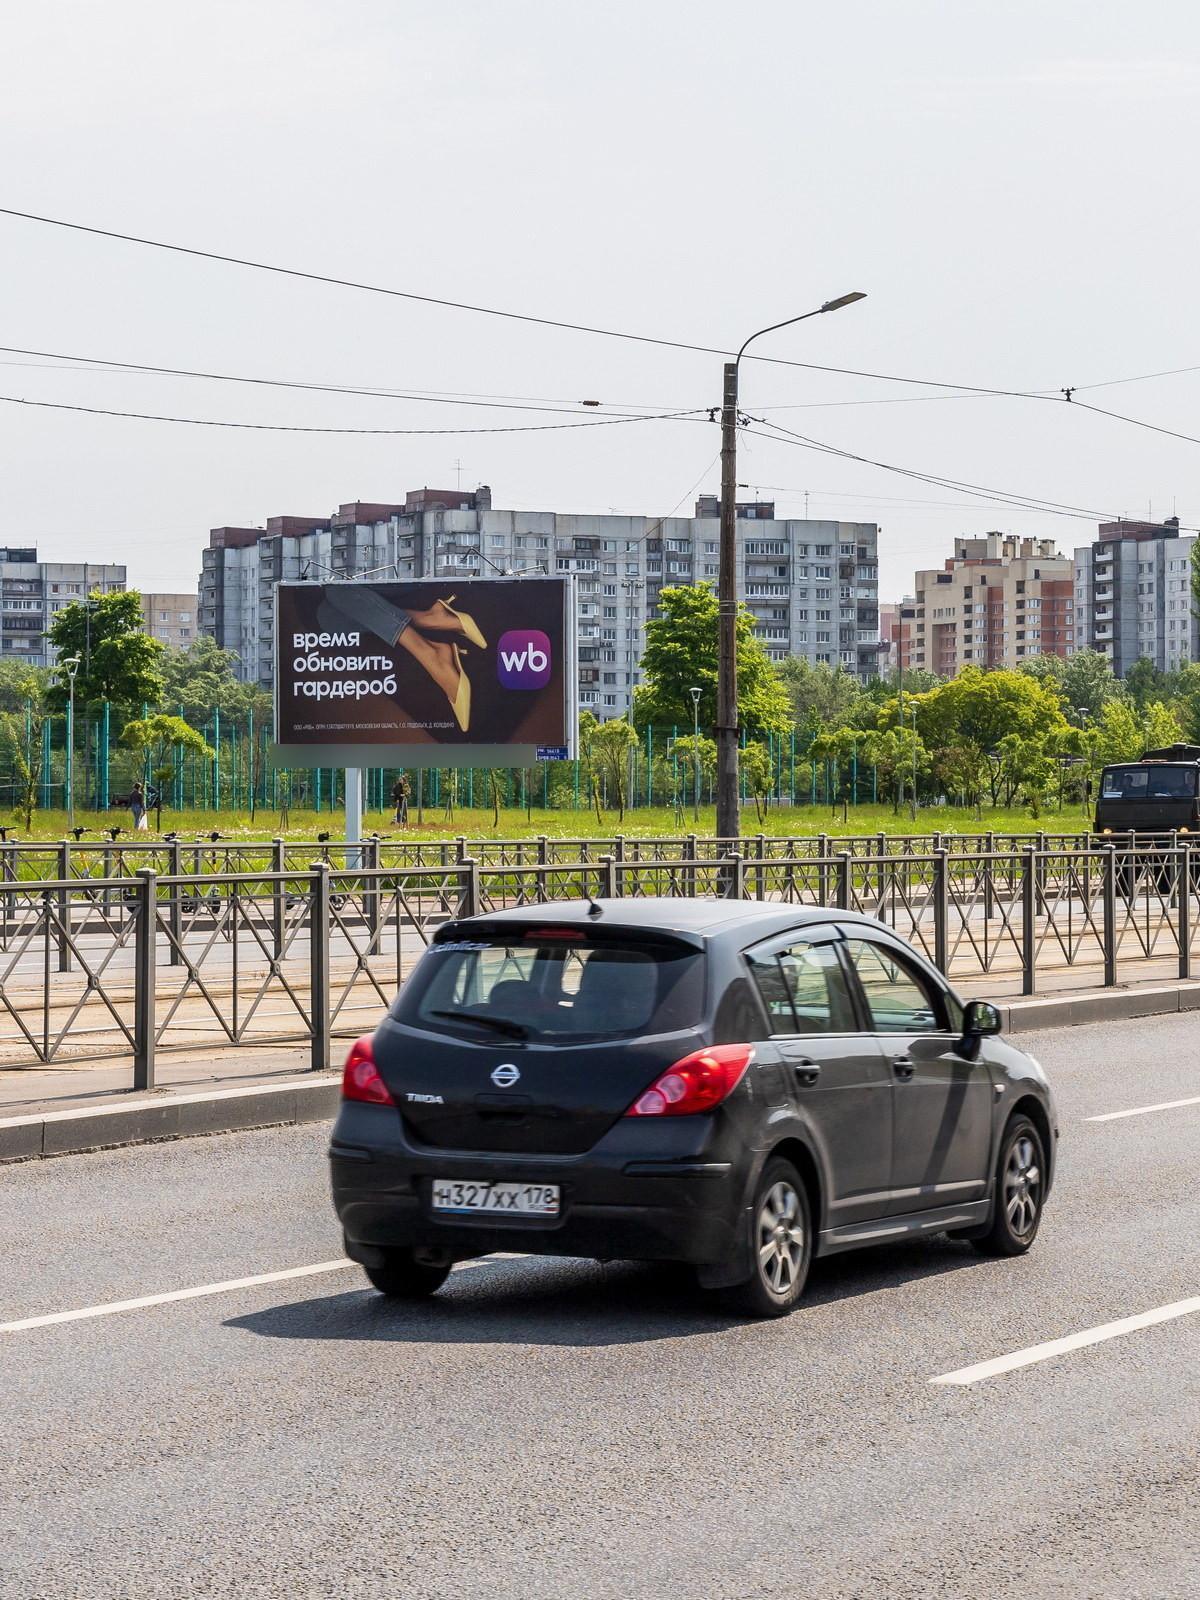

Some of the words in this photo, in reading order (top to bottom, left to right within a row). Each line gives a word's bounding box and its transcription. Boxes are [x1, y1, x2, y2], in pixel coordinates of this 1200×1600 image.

[293, 632, 360, 653] время
[293, 651, 394, 672] обновить
[500, 642, 548, 672] wb
[293, 674, 398, 701] гардероб
[439, 1184, 519, 1208] Н327ХХ
[523, 1187, 554, 1204] 178
